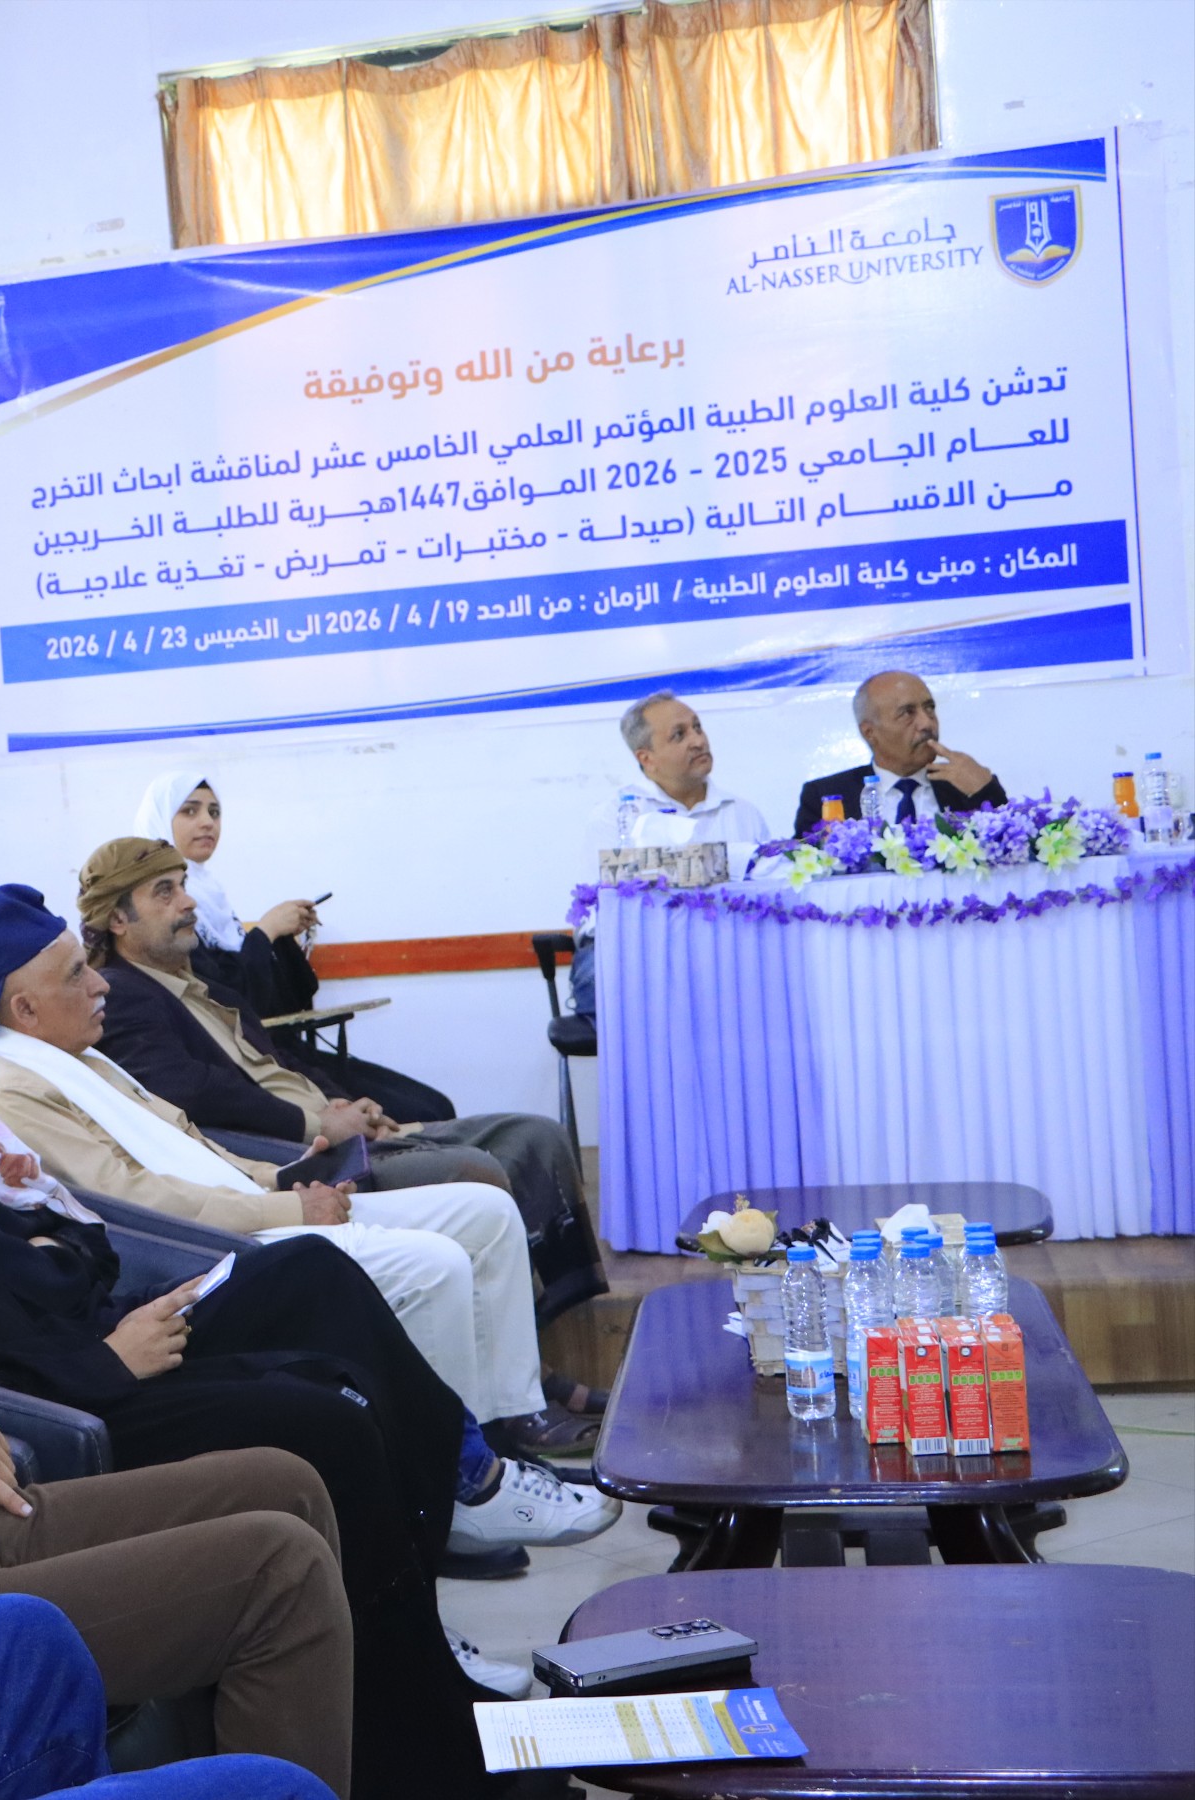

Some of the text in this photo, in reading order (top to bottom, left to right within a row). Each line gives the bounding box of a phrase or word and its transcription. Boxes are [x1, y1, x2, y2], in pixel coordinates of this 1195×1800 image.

[748, 217, 957, 269] جامعة الناصر
[725, 263, 849, 296] AL-NASSER
[847, 245, 985, 285] UNIVERSITY
[303, 333, 686, 405] برعاية من الله وتوفيقة
[31, 366, 1068, 509] تدشن كلية العلوم الطبية المؤتمر العلمي الخامس عشر لمناقشة ابحاث التخرج
[606, 458, 677, 490] 2026
[714, 446, 788, 479] 2025
[857, 558, 909, 590] كلية
[915, 554, 976, 585] مبنى
[998, 542, 1078, 578] المكان
[692, 571, 767, 605] الطبية
[773, 563, 850, 599] العلوم
[445, 599, 470, 624] 19
[476, 594, 532, 621] الاحد
[538, 596, 573, 621] من
[593, 582, 660, 616] الزمان
[193, 617, 280, 652] الخميس
[285, 613, 321, 643] الى
[324, 607, 382, 635] 2026
[45, 633, 100, 661] 2026
[160, 625, 188, 650] 23
